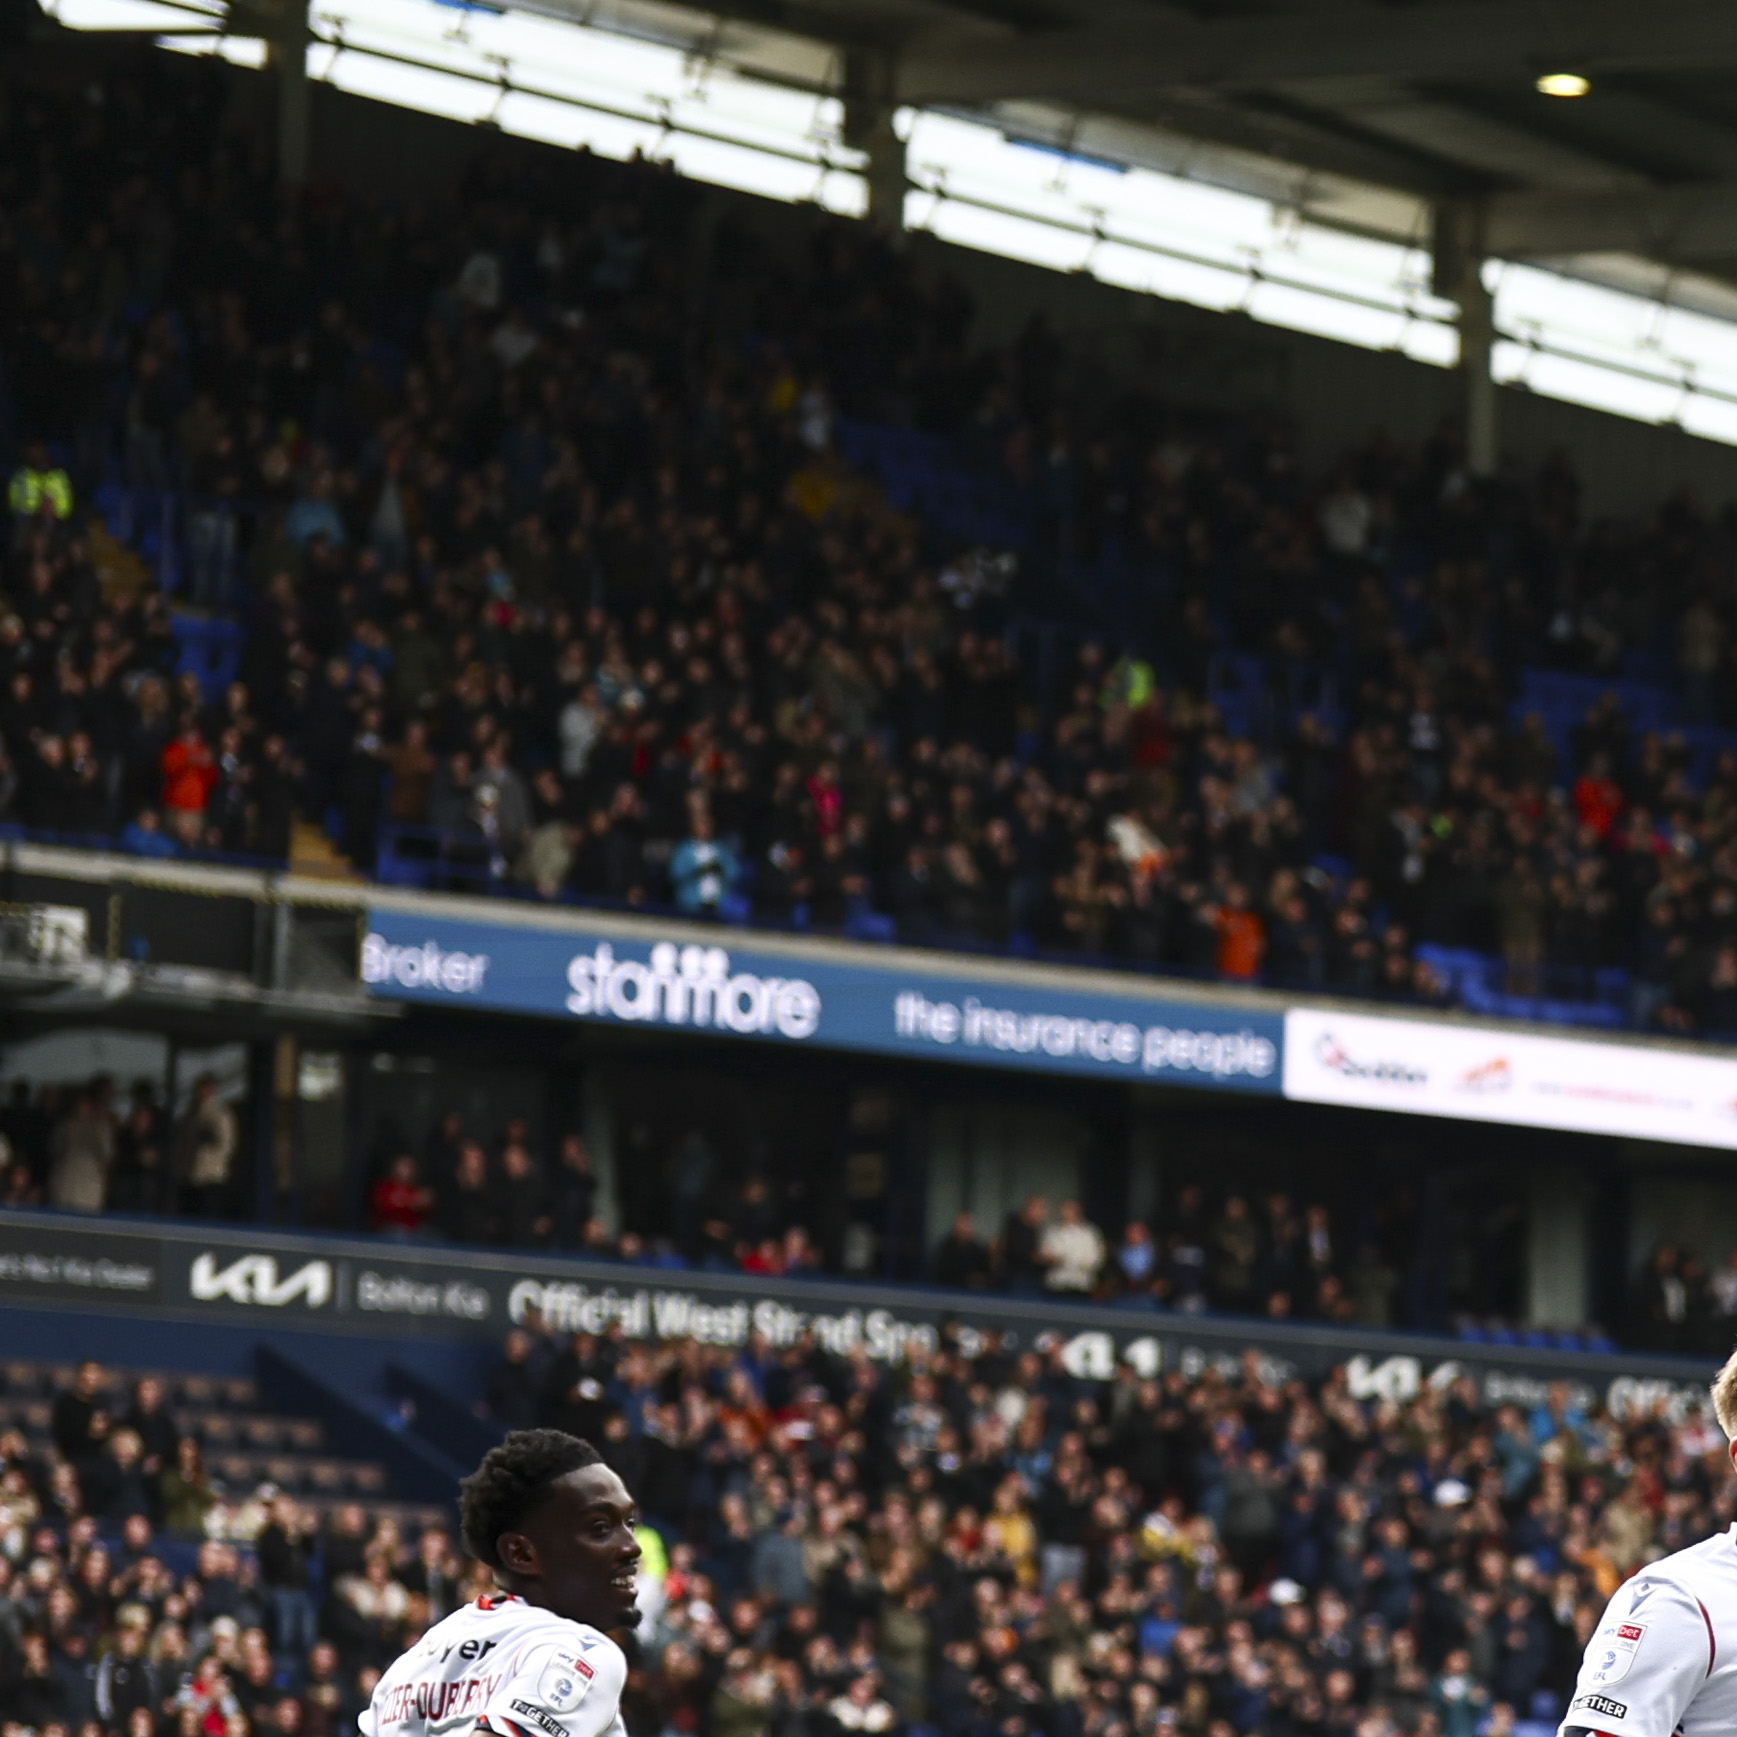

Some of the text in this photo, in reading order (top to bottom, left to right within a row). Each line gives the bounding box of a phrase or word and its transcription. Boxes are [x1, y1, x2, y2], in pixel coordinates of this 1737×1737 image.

[894, 988, 960, 1044] the
[963, 996, 1142, 1064] insurance
[1143, 1026, 1278, 1082] people
[653, 1290, 748, 1348] West
